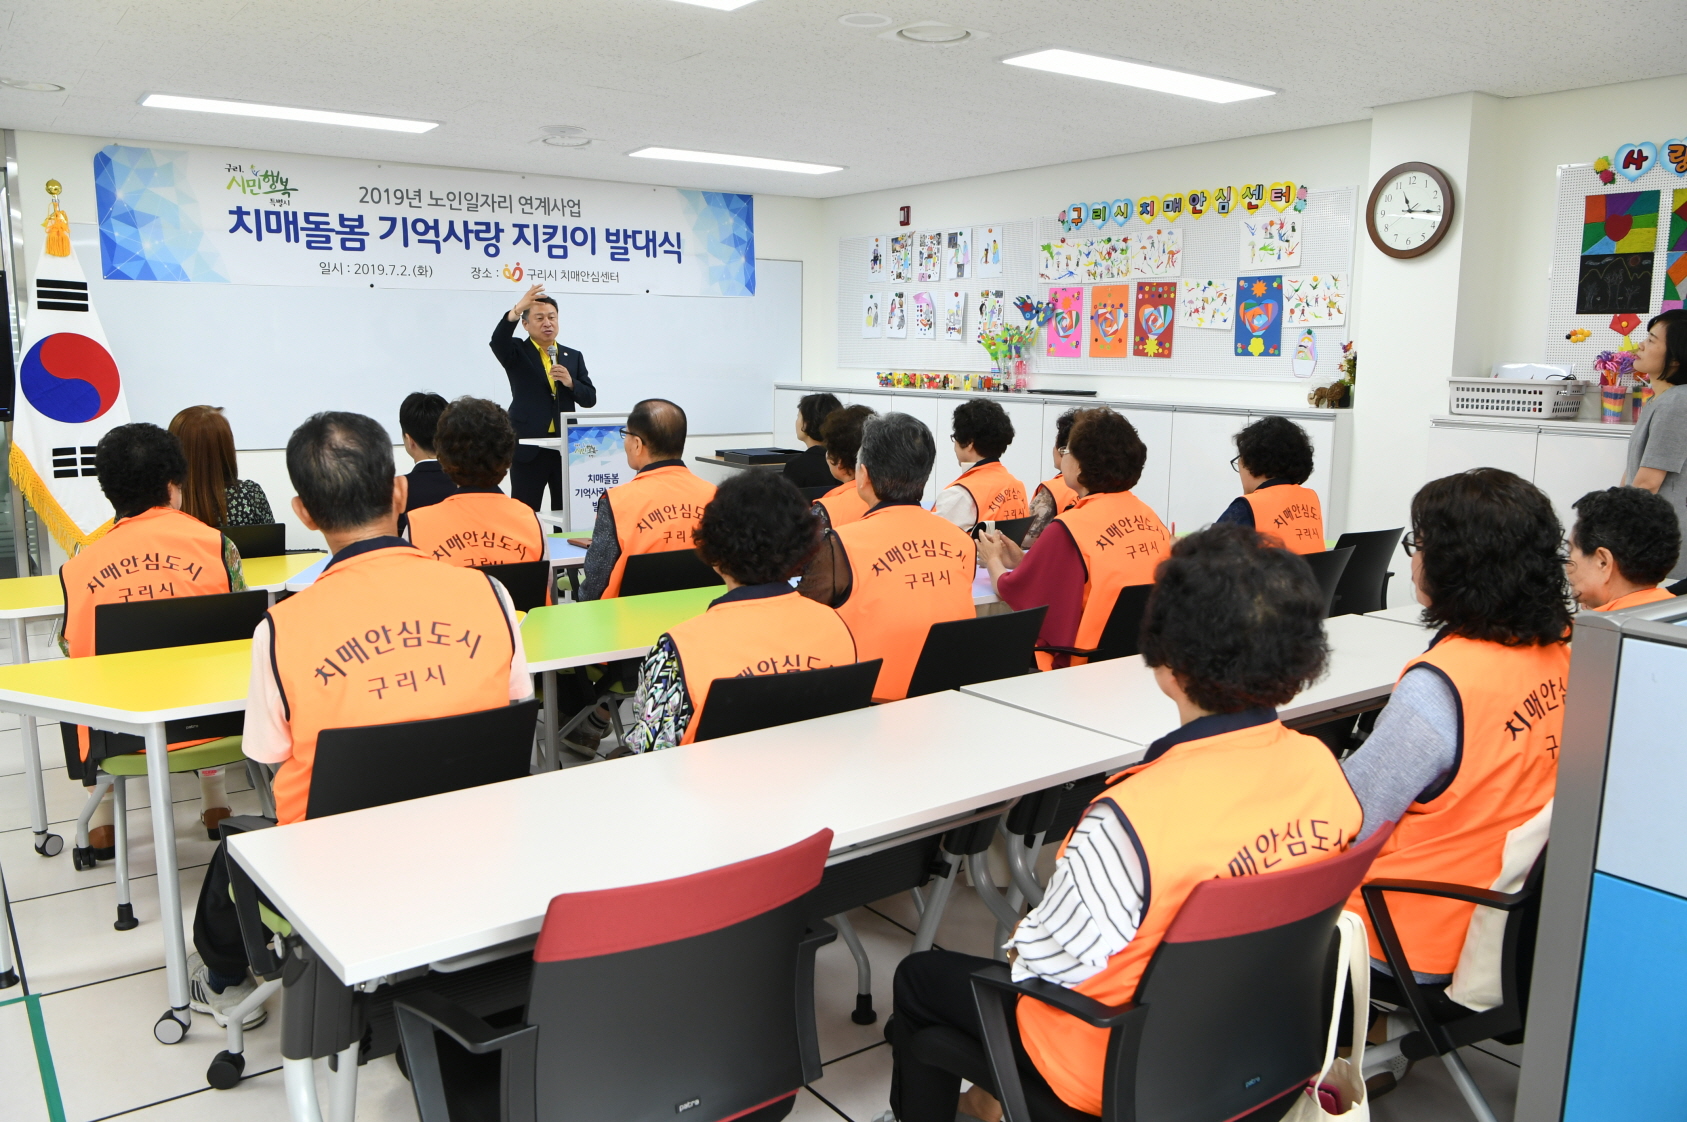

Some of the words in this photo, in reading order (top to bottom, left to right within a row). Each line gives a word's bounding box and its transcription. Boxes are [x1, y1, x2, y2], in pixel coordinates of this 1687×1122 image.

[226, 169, 299, 198] 시민행복
[1395, 182, 1402, 190] 11
[1408, 176, 1417, 185] 12
[1425, 179, 1428, 188] 1
[358, 186, 422, 209] 2019년
[427, 190, 513, 214] 노인일자리
[518, 195, 581, 217] 연계사업
[1384, 194, 1392, 203] 10
[1433, 190, 1438, 199] 2
[1071, 203, 1129, 226] 구리시
[1139, 184, 1291, 216] 치매안심센터
[1380, 210, 1386, 218] 9
[1384, 224, 1389, 232] 8
[1430, 221, 1436, 229] 4
[228, 205, 370, 252] 치매돌봄
[378, 216, 505, 258] 기억사랑
[512, 223, 597, 260] 지킴이
[605, 227, 682, 264] 발대식
[1393, 233, 1399, 242] 7
[1405, 237, 1411, 245] 6
[1420, 233, 1426, 241] 5
[319, 261, 343, 275] 일시
[354, 263, 433, 278] 2019.7.2.(화)
[470, 266, 493, 280] 장소
[526, 268, 557, 282] 구리시
[560, 270, 620, 283] 치매안심센터
[588, 473, 620, 485] 치매돌봄
[1294, 528, 1320, 540] 구리시
[432, 531, 527, 561] 치매안심도시
[1125, 541, 1160, 559] 구리시
[86, 552, 203, 594] 치매안심도시
[905, 569, 951, 590] 구리시
[118, 582, 175, 603] 구리시
[314, 620, 482, 687] 치매안심도시
[368, 664, 446, 700] 구리시
[679, 1099, 700, 1113] patra
